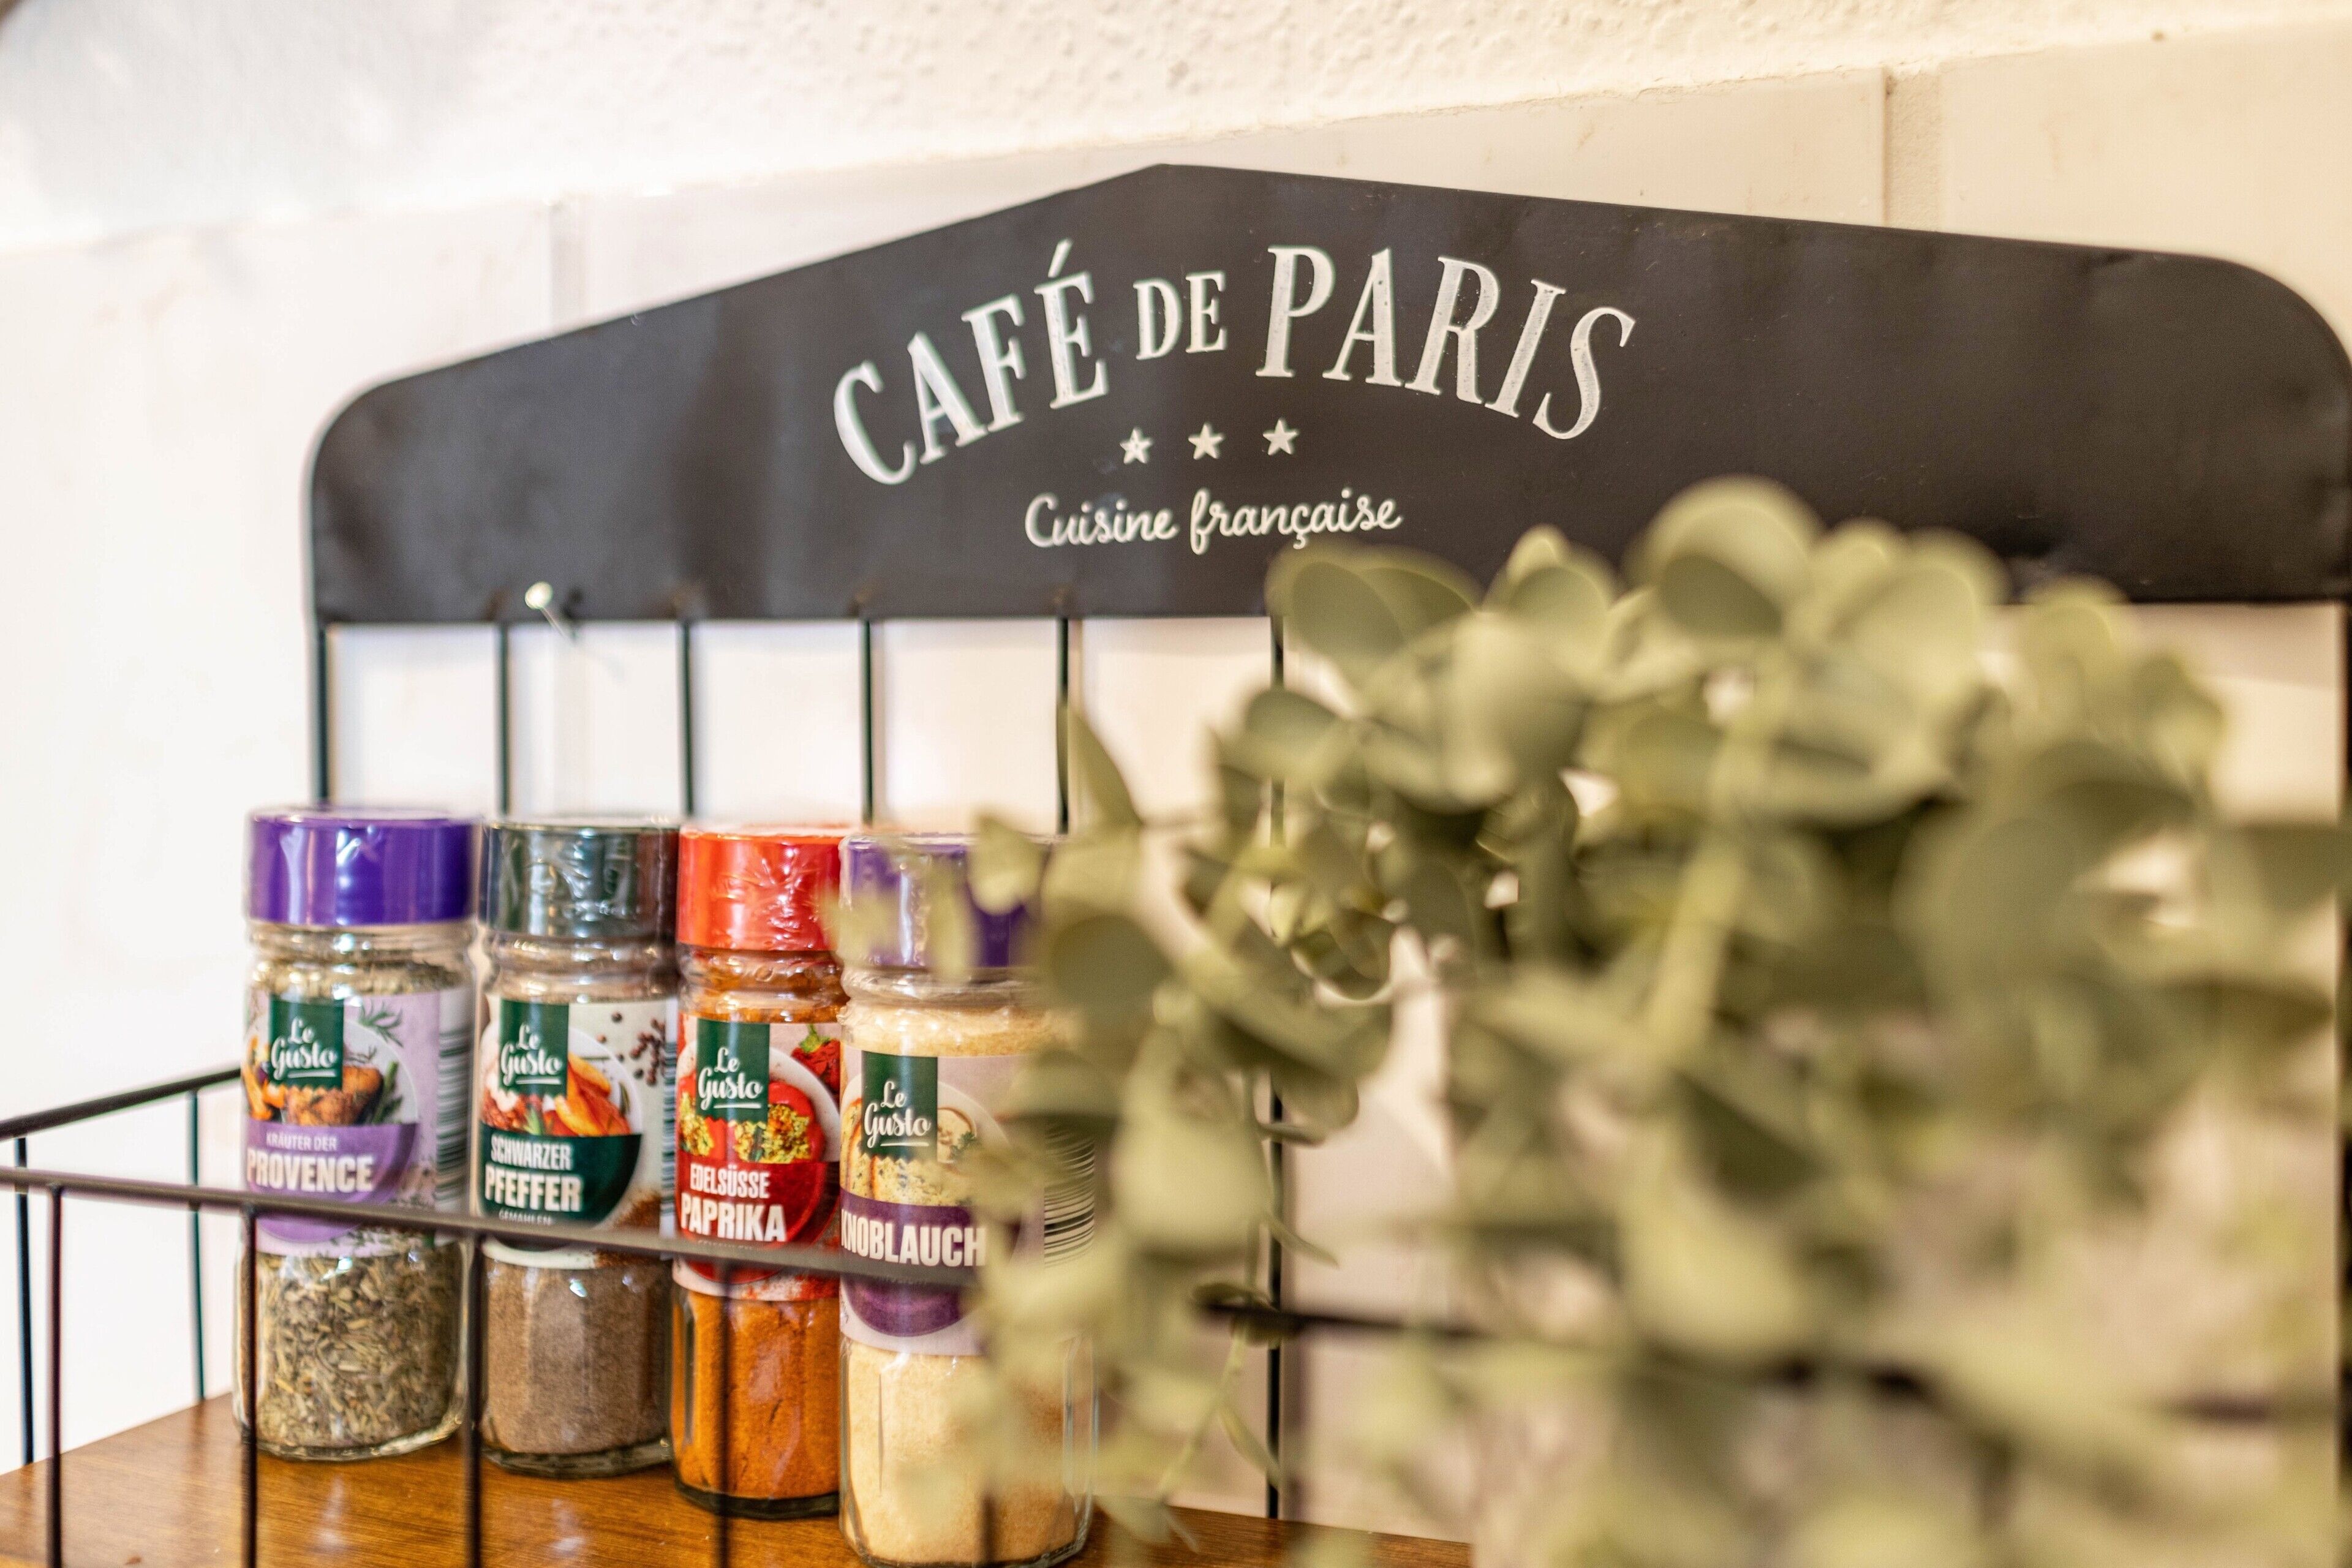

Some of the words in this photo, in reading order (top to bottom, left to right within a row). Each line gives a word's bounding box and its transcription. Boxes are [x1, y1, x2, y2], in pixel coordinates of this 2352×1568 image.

[833, 239, 1109, 486] CAFÉ
[1134, 271, 1226, 361] DE
[1255, 246, 1636, 441] PARIS
[1025, 495, 1180, 549] Cuisine
[1189, 488, 1403, 556] française
[290, 1016, 315, 1044] Le
[516, 1023, 540, 1051] Le
[271, 1037, 339, 1080] Gusto
[500, 1045, 563, 1087] Gusto
[713, 1046, 741, 1074] Le
[698, 1066, 763, 1111] Gusto
[880, 1080, 907, 1109] Le
[314, 1136, 338, 1152] DER
[864, 1101, 932, 1149] Gusto
[246, 1147, 374, 1193] PROVENCE
[491, 1134, 573, 1171] SCHWARZER
[484, 1164, 584, 1213] PFEFFER
[690, 1161, 771, 1199] EDELSÜSSE
[680, 1192, 788, 1243] PAPRIKA
[841, 1208, 987, 1268] KNOBLAUCH
